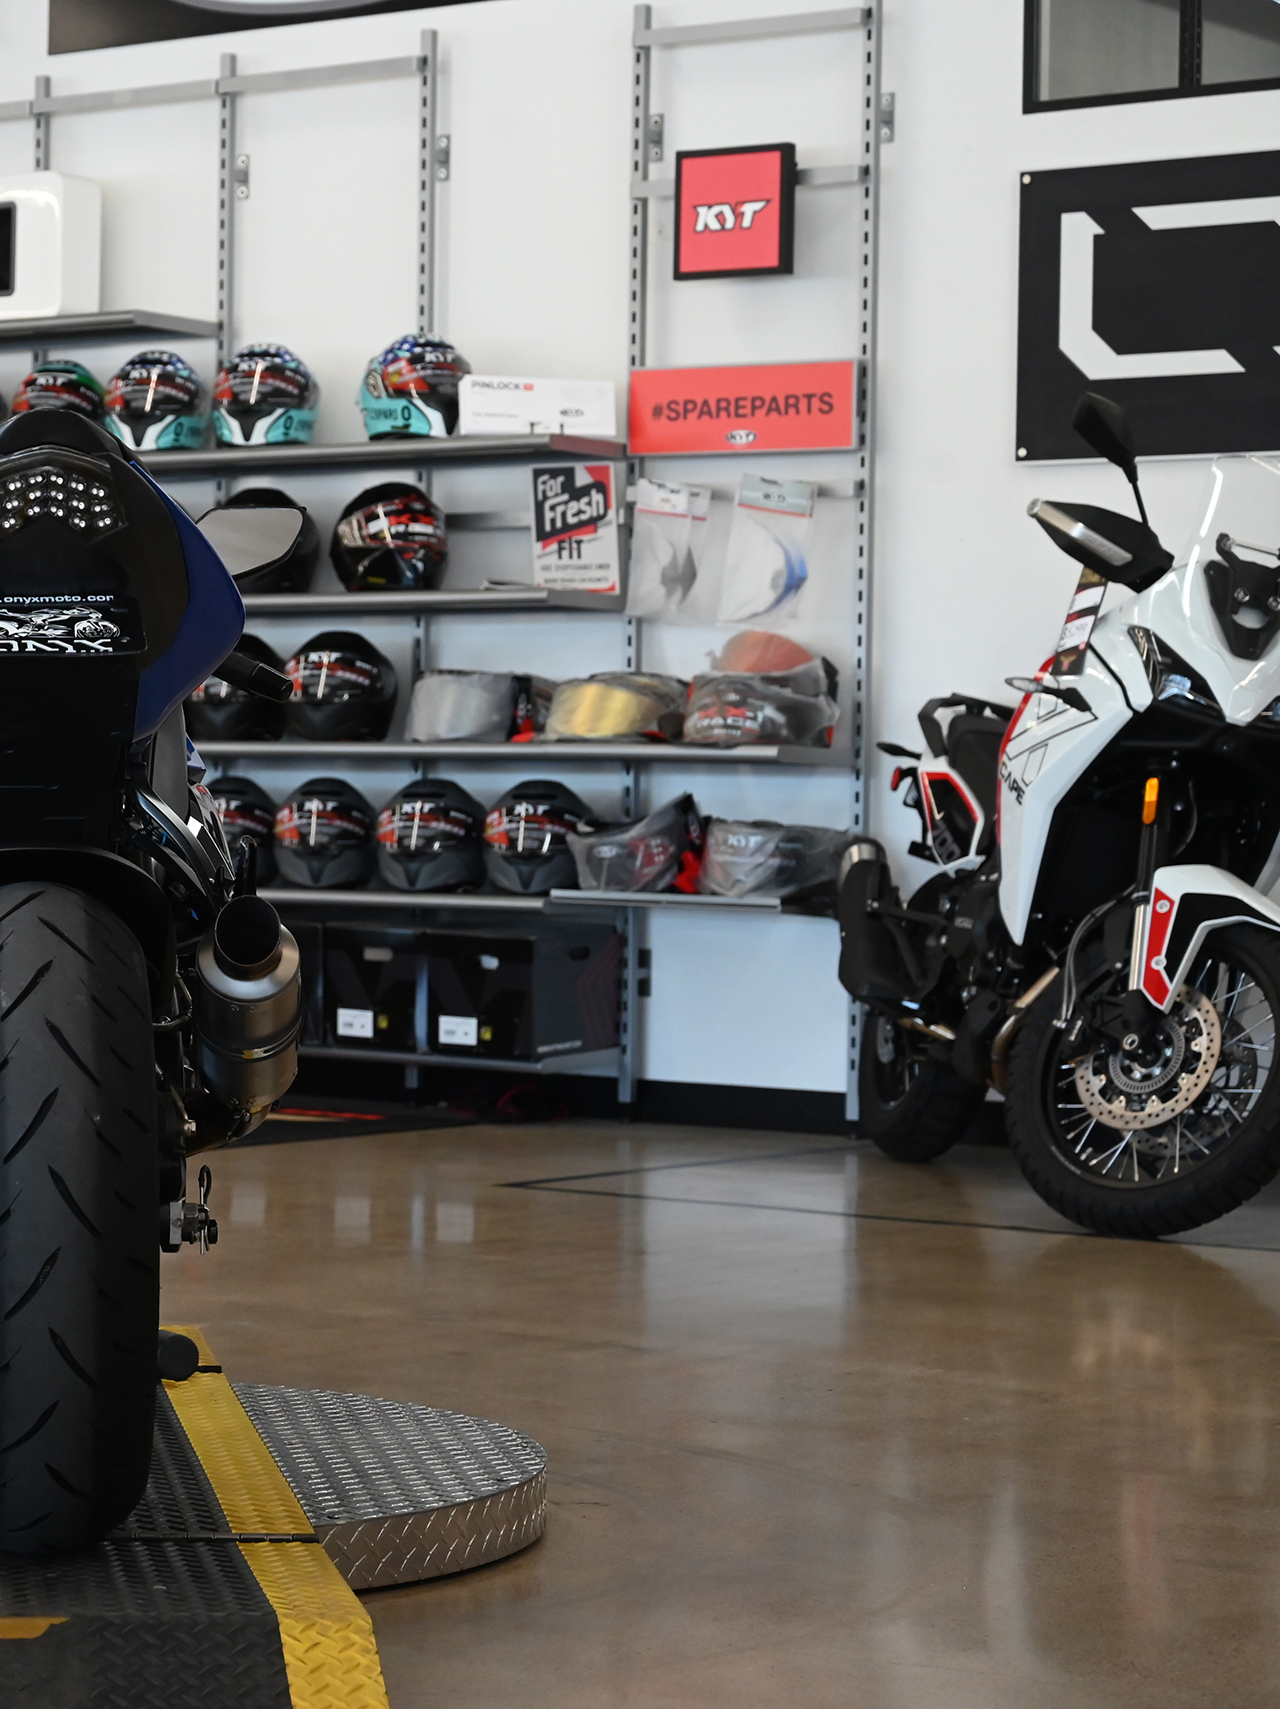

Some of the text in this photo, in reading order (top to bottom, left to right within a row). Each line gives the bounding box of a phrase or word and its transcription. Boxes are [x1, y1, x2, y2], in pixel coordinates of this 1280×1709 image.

[693, 199, 771, 233] KYT
[471, 379, 521, 391] PINLOCK
[651, 392, 834, 421] #SPAREPARTS
[537, 473, 565, 501] For
[544, 488, 605, 532] Fresh
[557, 536, 583, 560] FIT
